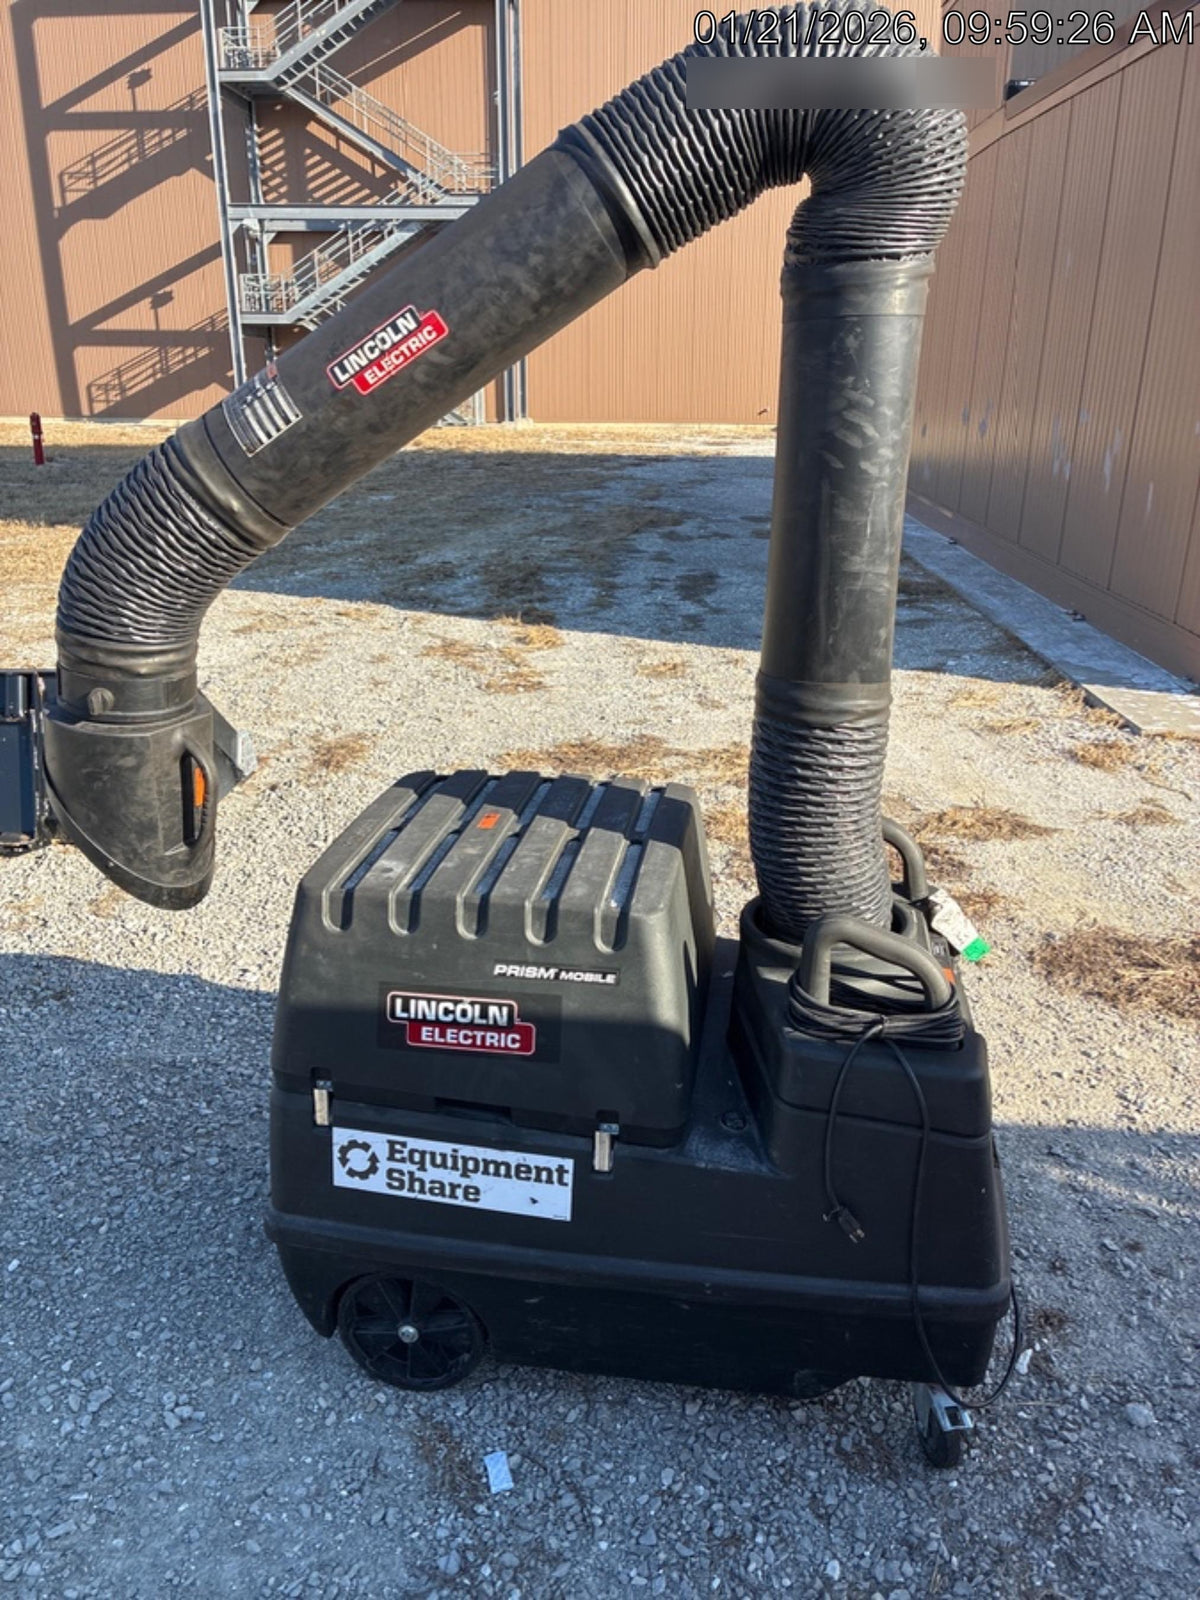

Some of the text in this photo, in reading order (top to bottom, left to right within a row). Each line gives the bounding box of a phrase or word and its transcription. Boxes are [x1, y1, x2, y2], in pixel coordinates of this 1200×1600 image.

[333, 312, 418, 386] LINCOLN
[363, 325, 438, 385] ELECTRIC
[559, 970, 617, 984] MOBILE
[395, 997, 509, 1027] LINCOLN
[420, 1026, 521, 1049] ELECTRIC
[385, 1138, 570, 1187] Equipment
[385, 1167, 481, 1203] Share
